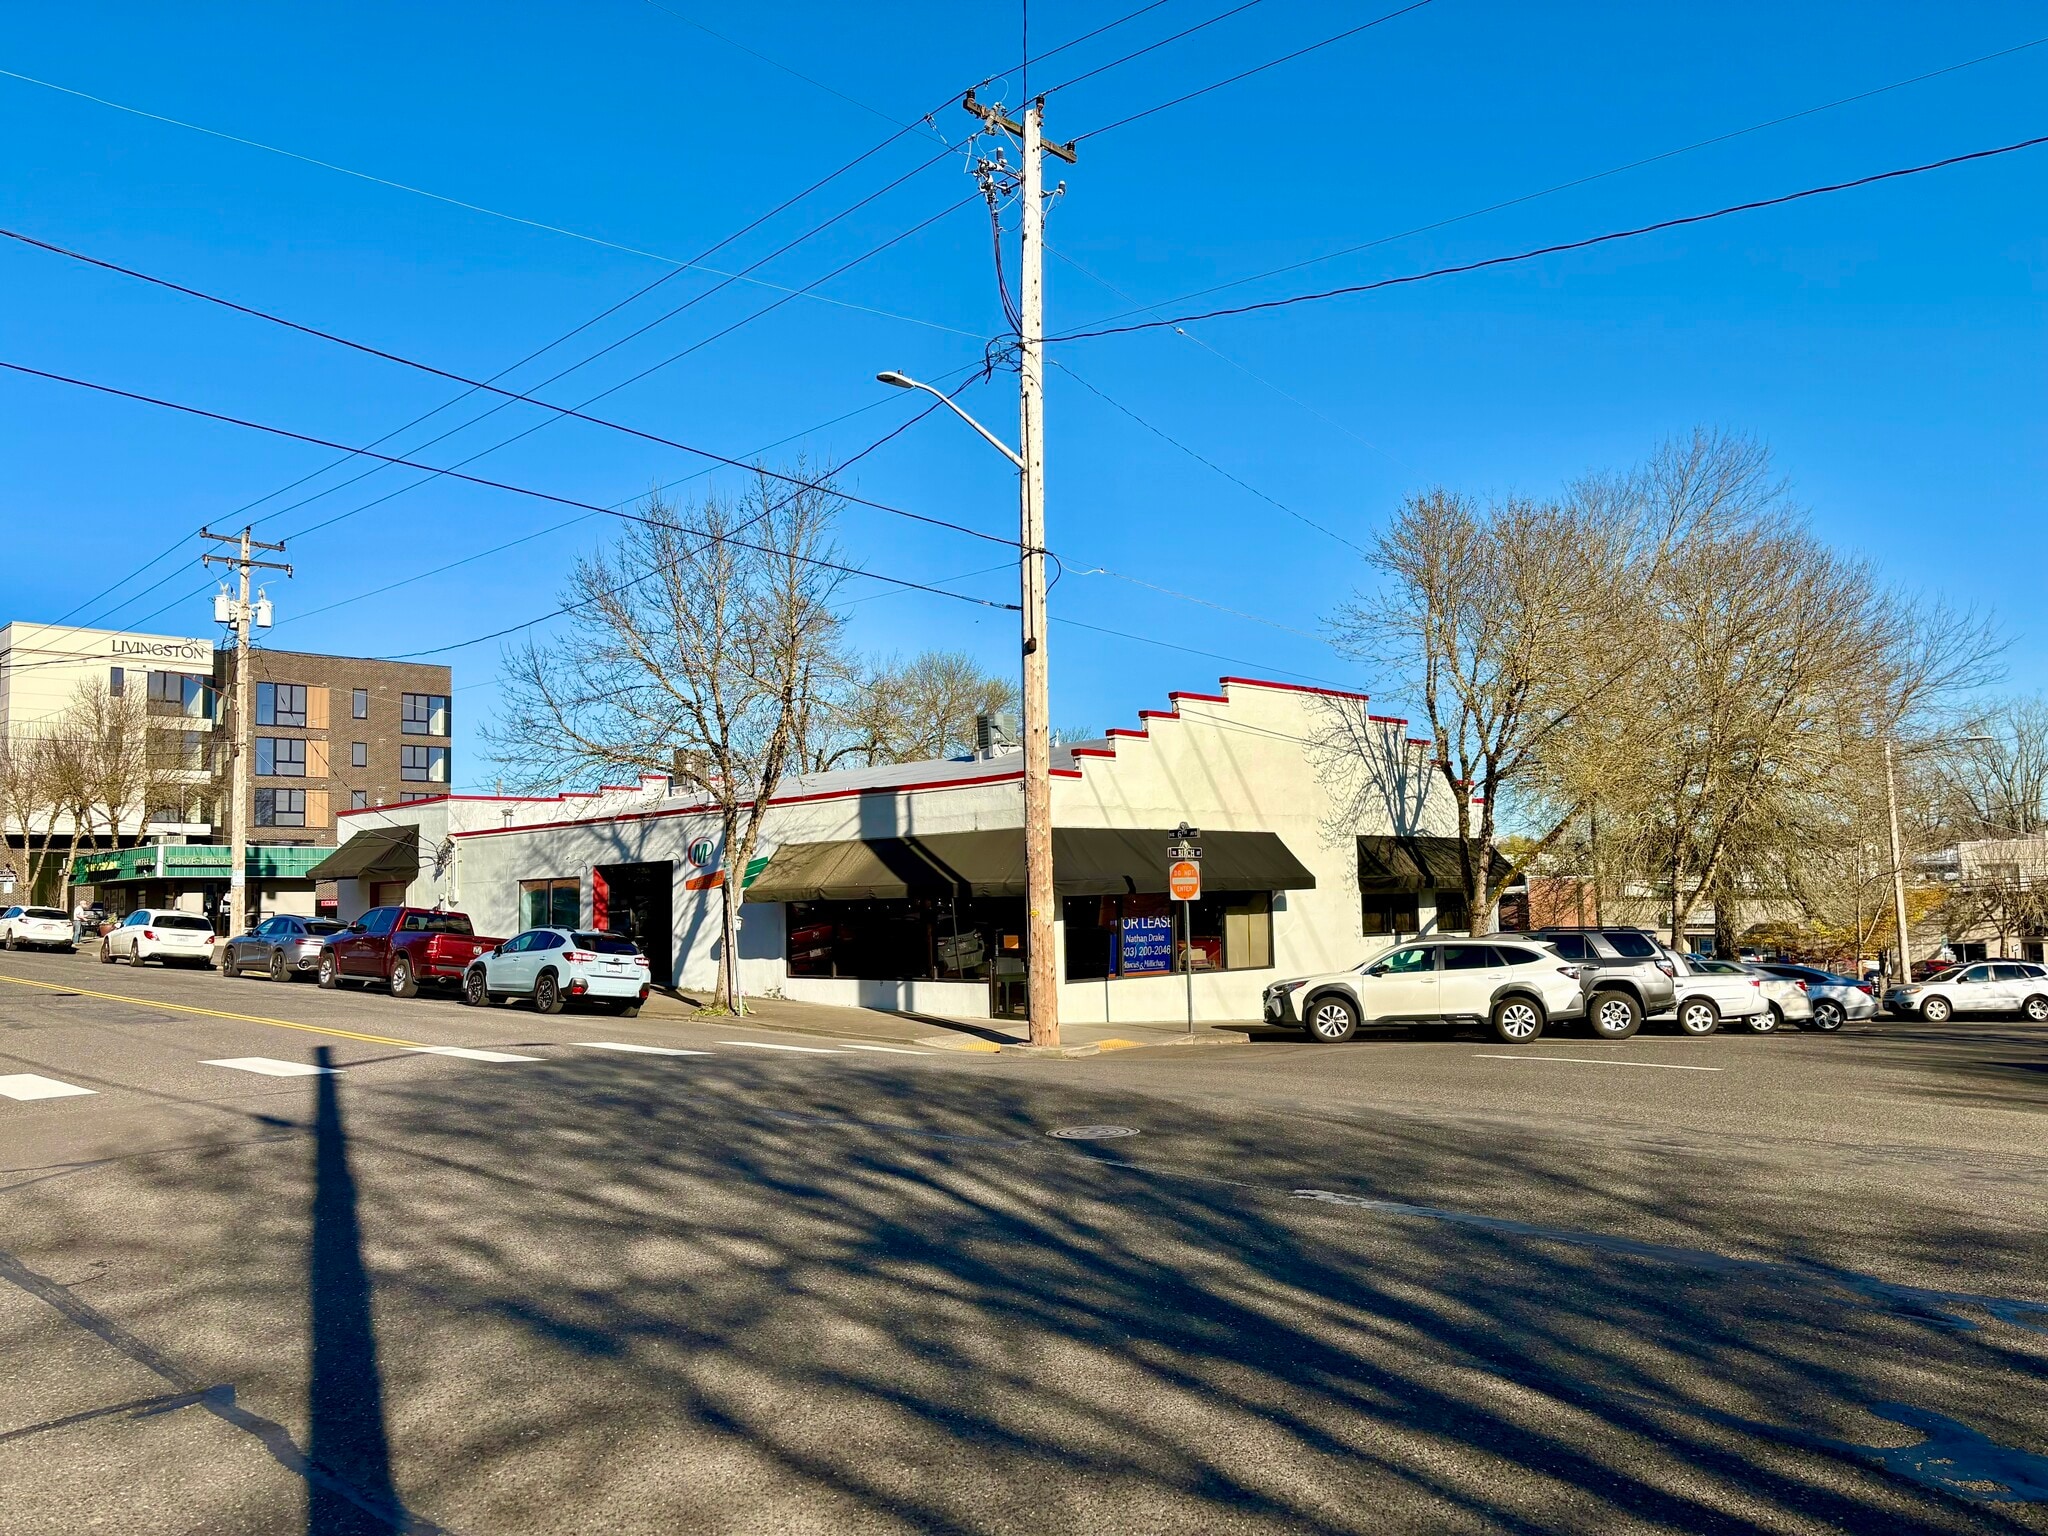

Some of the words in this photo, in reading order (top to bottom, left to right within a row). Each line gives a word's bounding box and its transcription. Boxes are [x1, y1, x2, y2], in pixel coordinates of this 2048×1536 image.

[112, 639, 204, 660] LIVINGSTON
[1178, 849, 1195, 858] BIRCH
[1122, 917, 1139, 930] OR
[1126, 934, 1147, 943] Nathan
[1148, 933, 1165, 942] Drake
[1138, 945, 1171, 956] 200-2046
